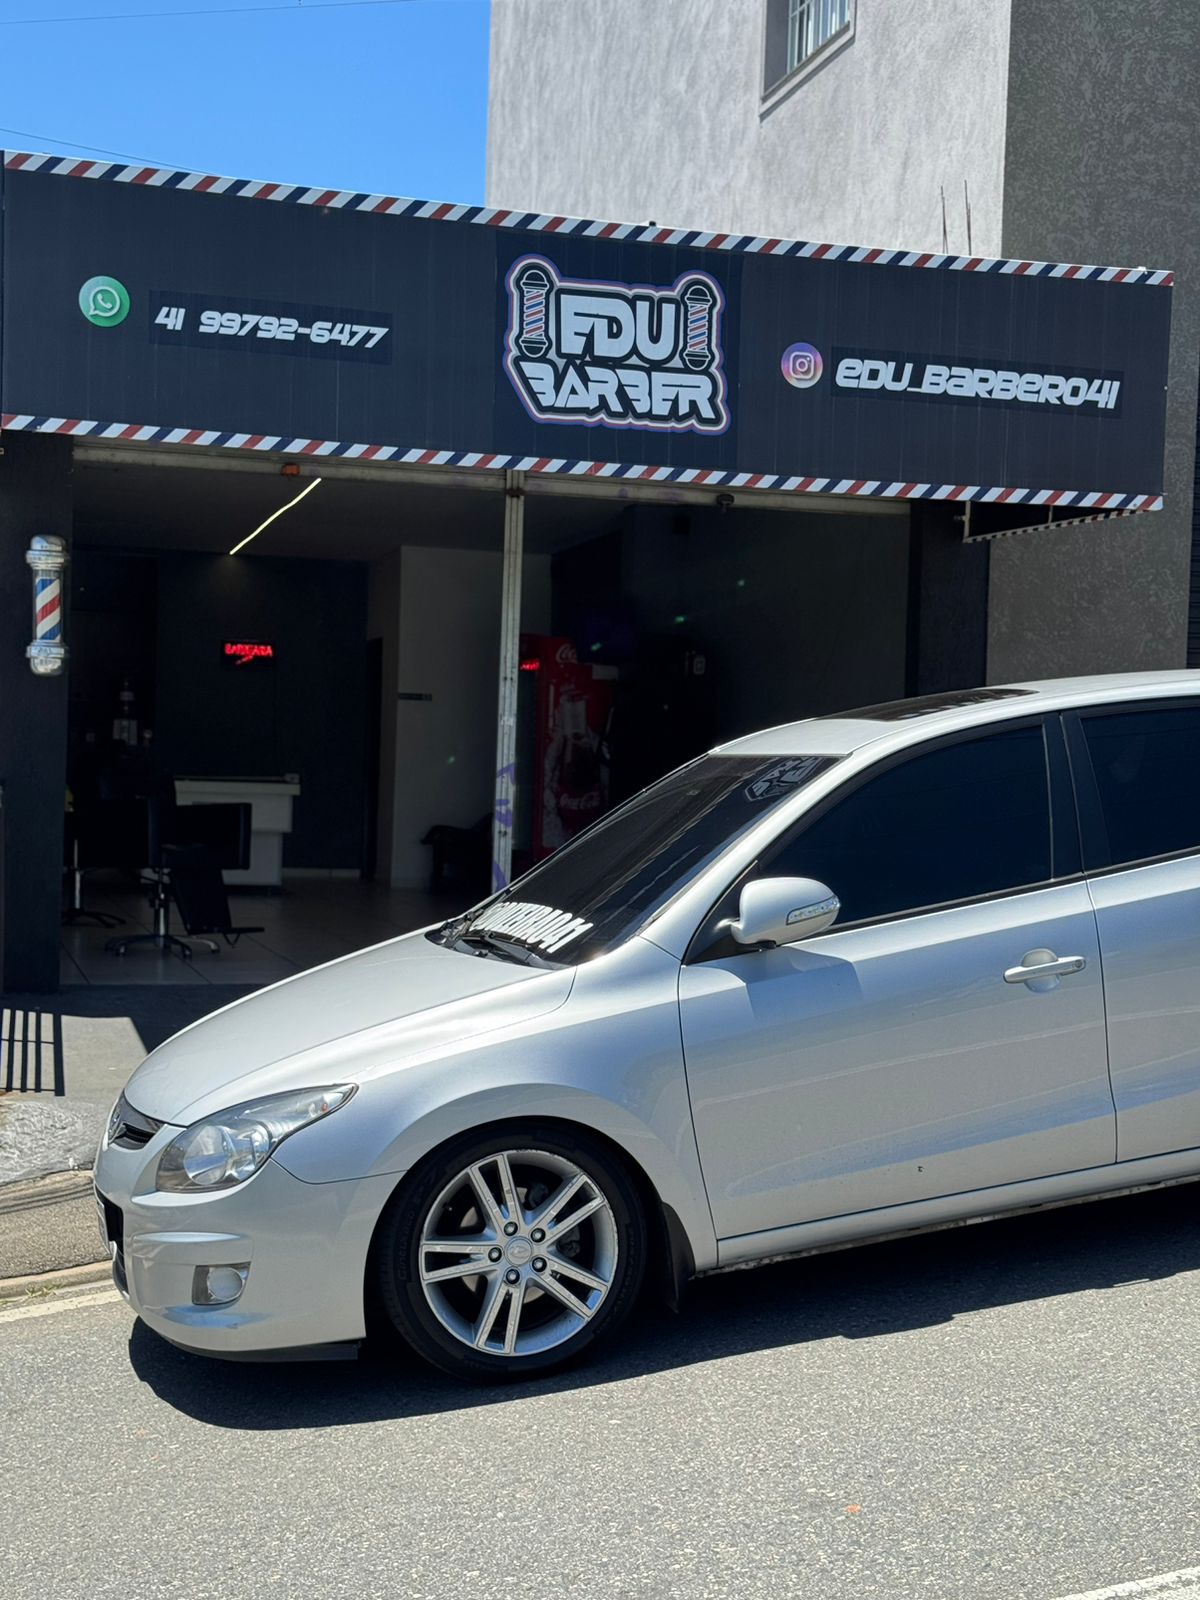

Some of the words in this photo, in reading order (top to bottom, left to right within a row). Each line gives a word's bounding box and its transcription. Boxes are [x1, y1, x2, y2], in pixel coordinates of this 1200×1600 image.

[154, 306, 185, 331] 41
[199, 310, 390, 348] 99792-6477
[561, 294, 676, 361] EDU
[520, 361, 716, 419] BARBER
